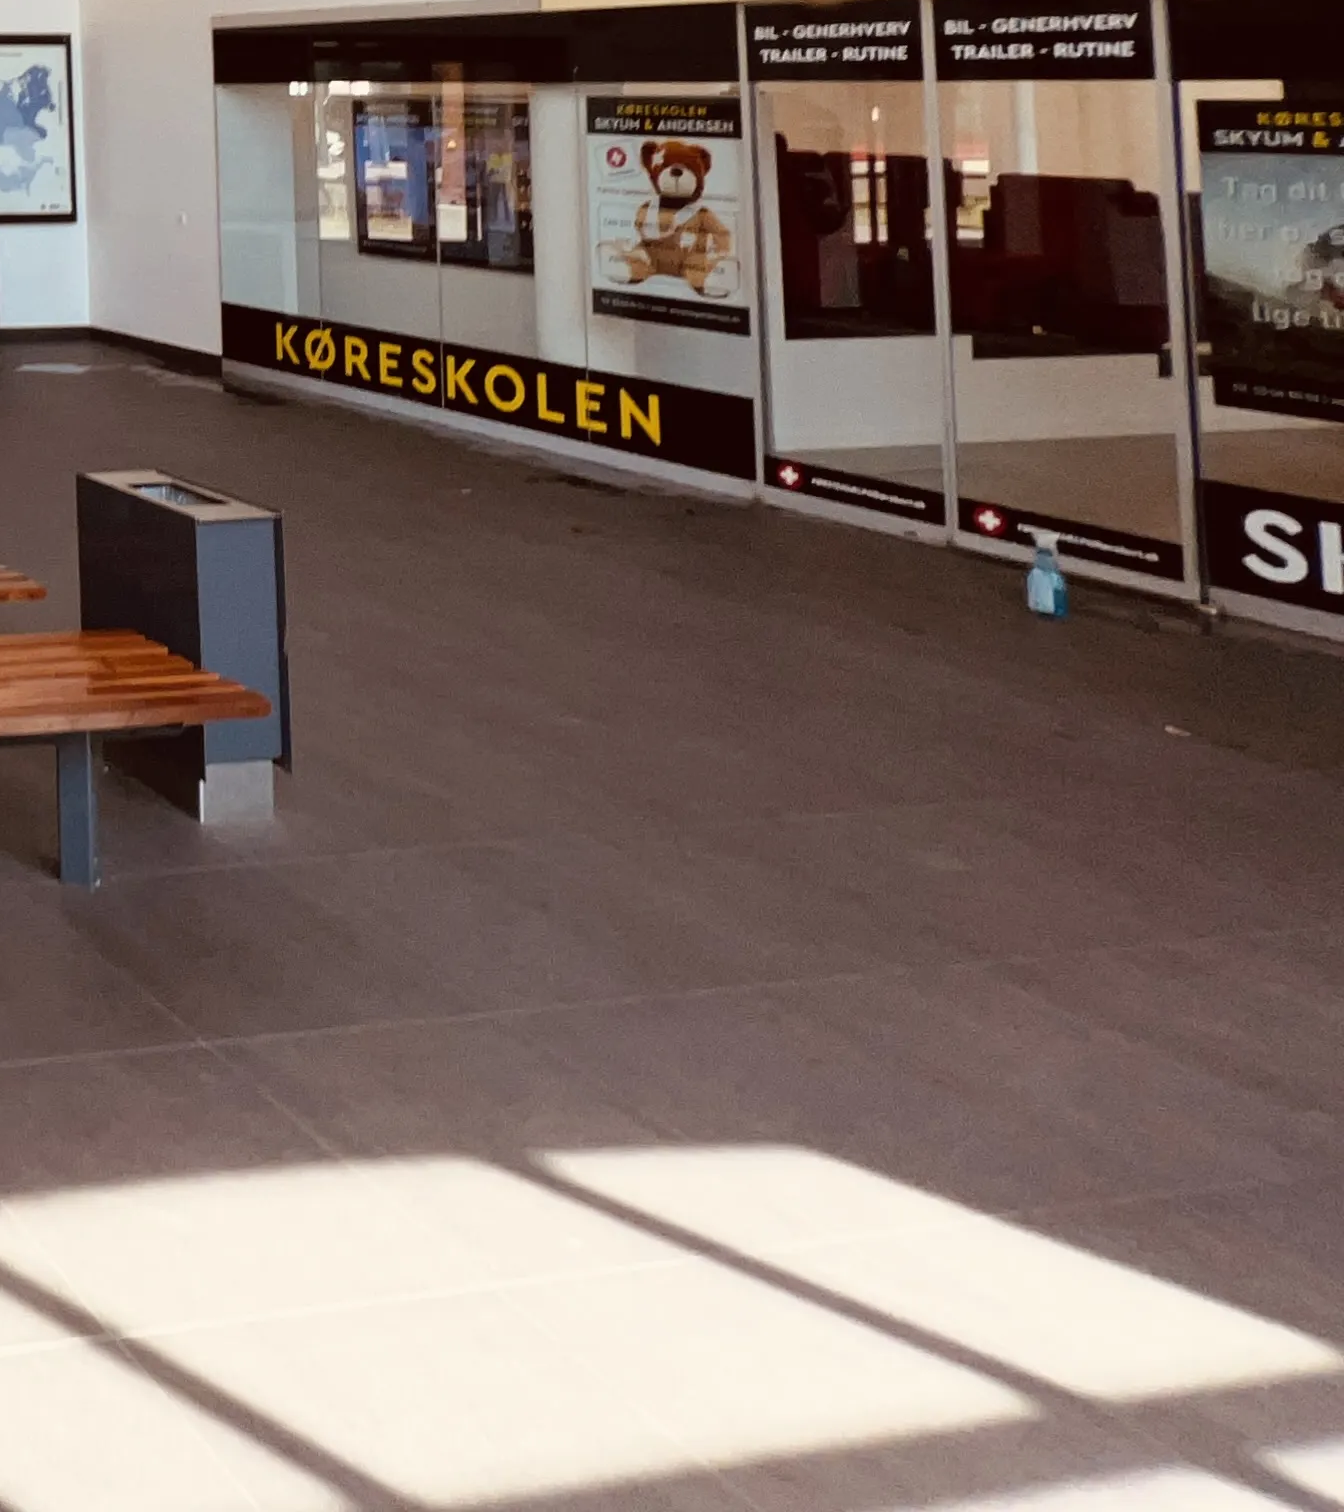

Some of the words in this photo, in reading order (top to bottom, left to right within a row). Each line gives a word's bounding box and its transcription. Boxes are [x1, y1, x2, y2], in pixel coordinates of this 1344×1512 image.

[754, 26, 780, 41] BIL
[792, 20, 912, 40] GENERHVERV
[944, 19, 975, 35] BIL
[991, 12, 1139, 34] GENERHVERV
[759, 46, 828, 64] TRAILER
[842, 44, 909, 62] RUTINE
[950, 42, 1035, 61] TRAILER
[1053, 40, 1136, 59] RUTINE
[615, 103, 708, 117] KØRESKOLEN
[594, 117, 641, 132] SKYUM
[644, 118, 654, 131] &
[656, 119, 734, 133] ANDERSEN
[1213, 129, 1305, 147] SKYUM
[1312, 131, 1330, 148] &
[275, 322, 662, 446] KØRESKOLEN
